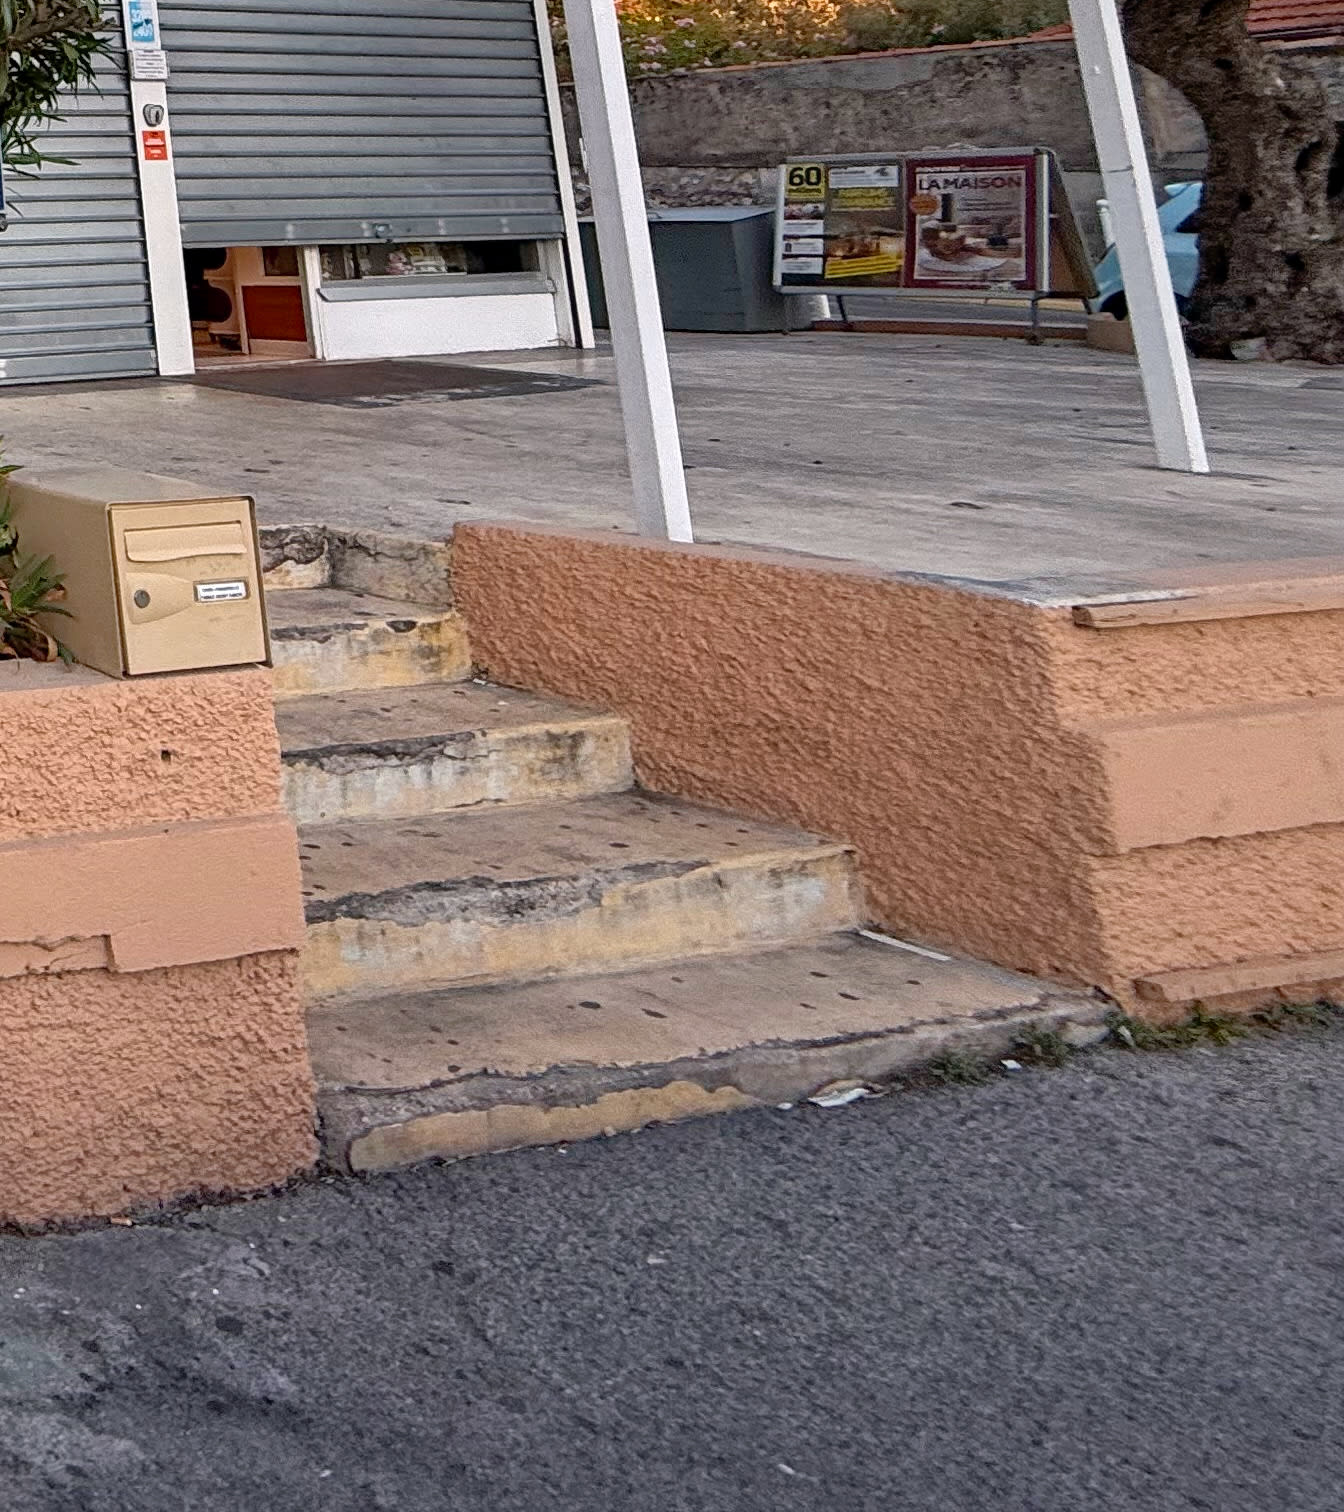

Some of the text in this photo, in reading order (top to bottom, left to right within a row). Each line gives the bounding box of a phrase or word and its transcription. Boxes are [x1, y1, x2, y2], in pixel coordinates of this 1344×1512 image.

[788, 166, 822, 186] 60
[918, 176, 1022, 191] LA MAISON
